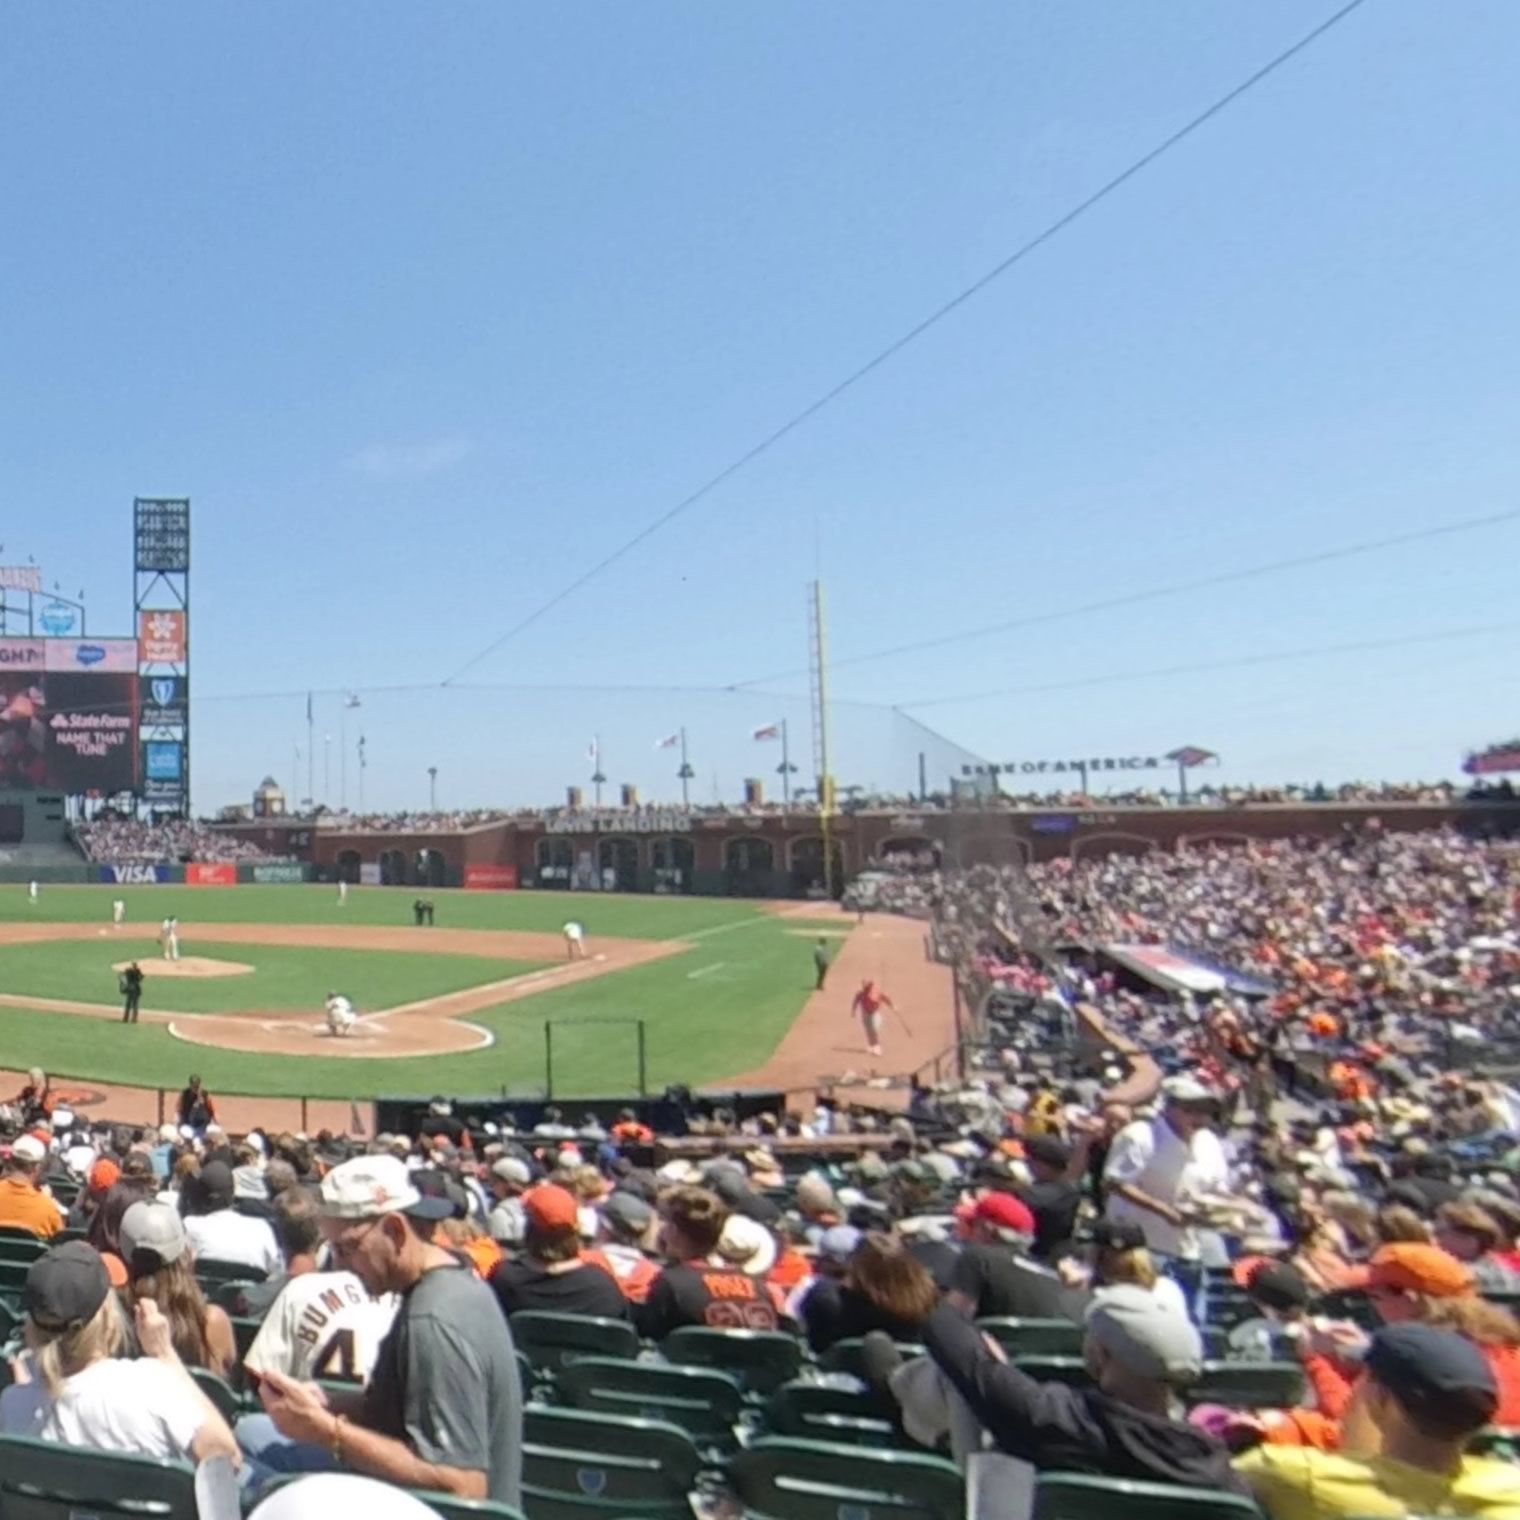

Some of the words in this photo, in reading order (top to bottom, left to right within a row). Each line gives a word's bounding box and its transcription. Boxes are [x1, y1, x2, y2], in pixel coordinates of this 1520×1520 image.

[56, 731, 90, 744] NAME
[94, 732, 125, 744] THAT
[76, 743, 106, 755] TUNE
[961, 763, 1016, 776] BANK
[1021, 761, 1047, 774] OF
[1054, 757, 1159, 772] AMERICA
[112, 865, 157, 882] VISA
[297, 1283, 399, 1346] BUMG
